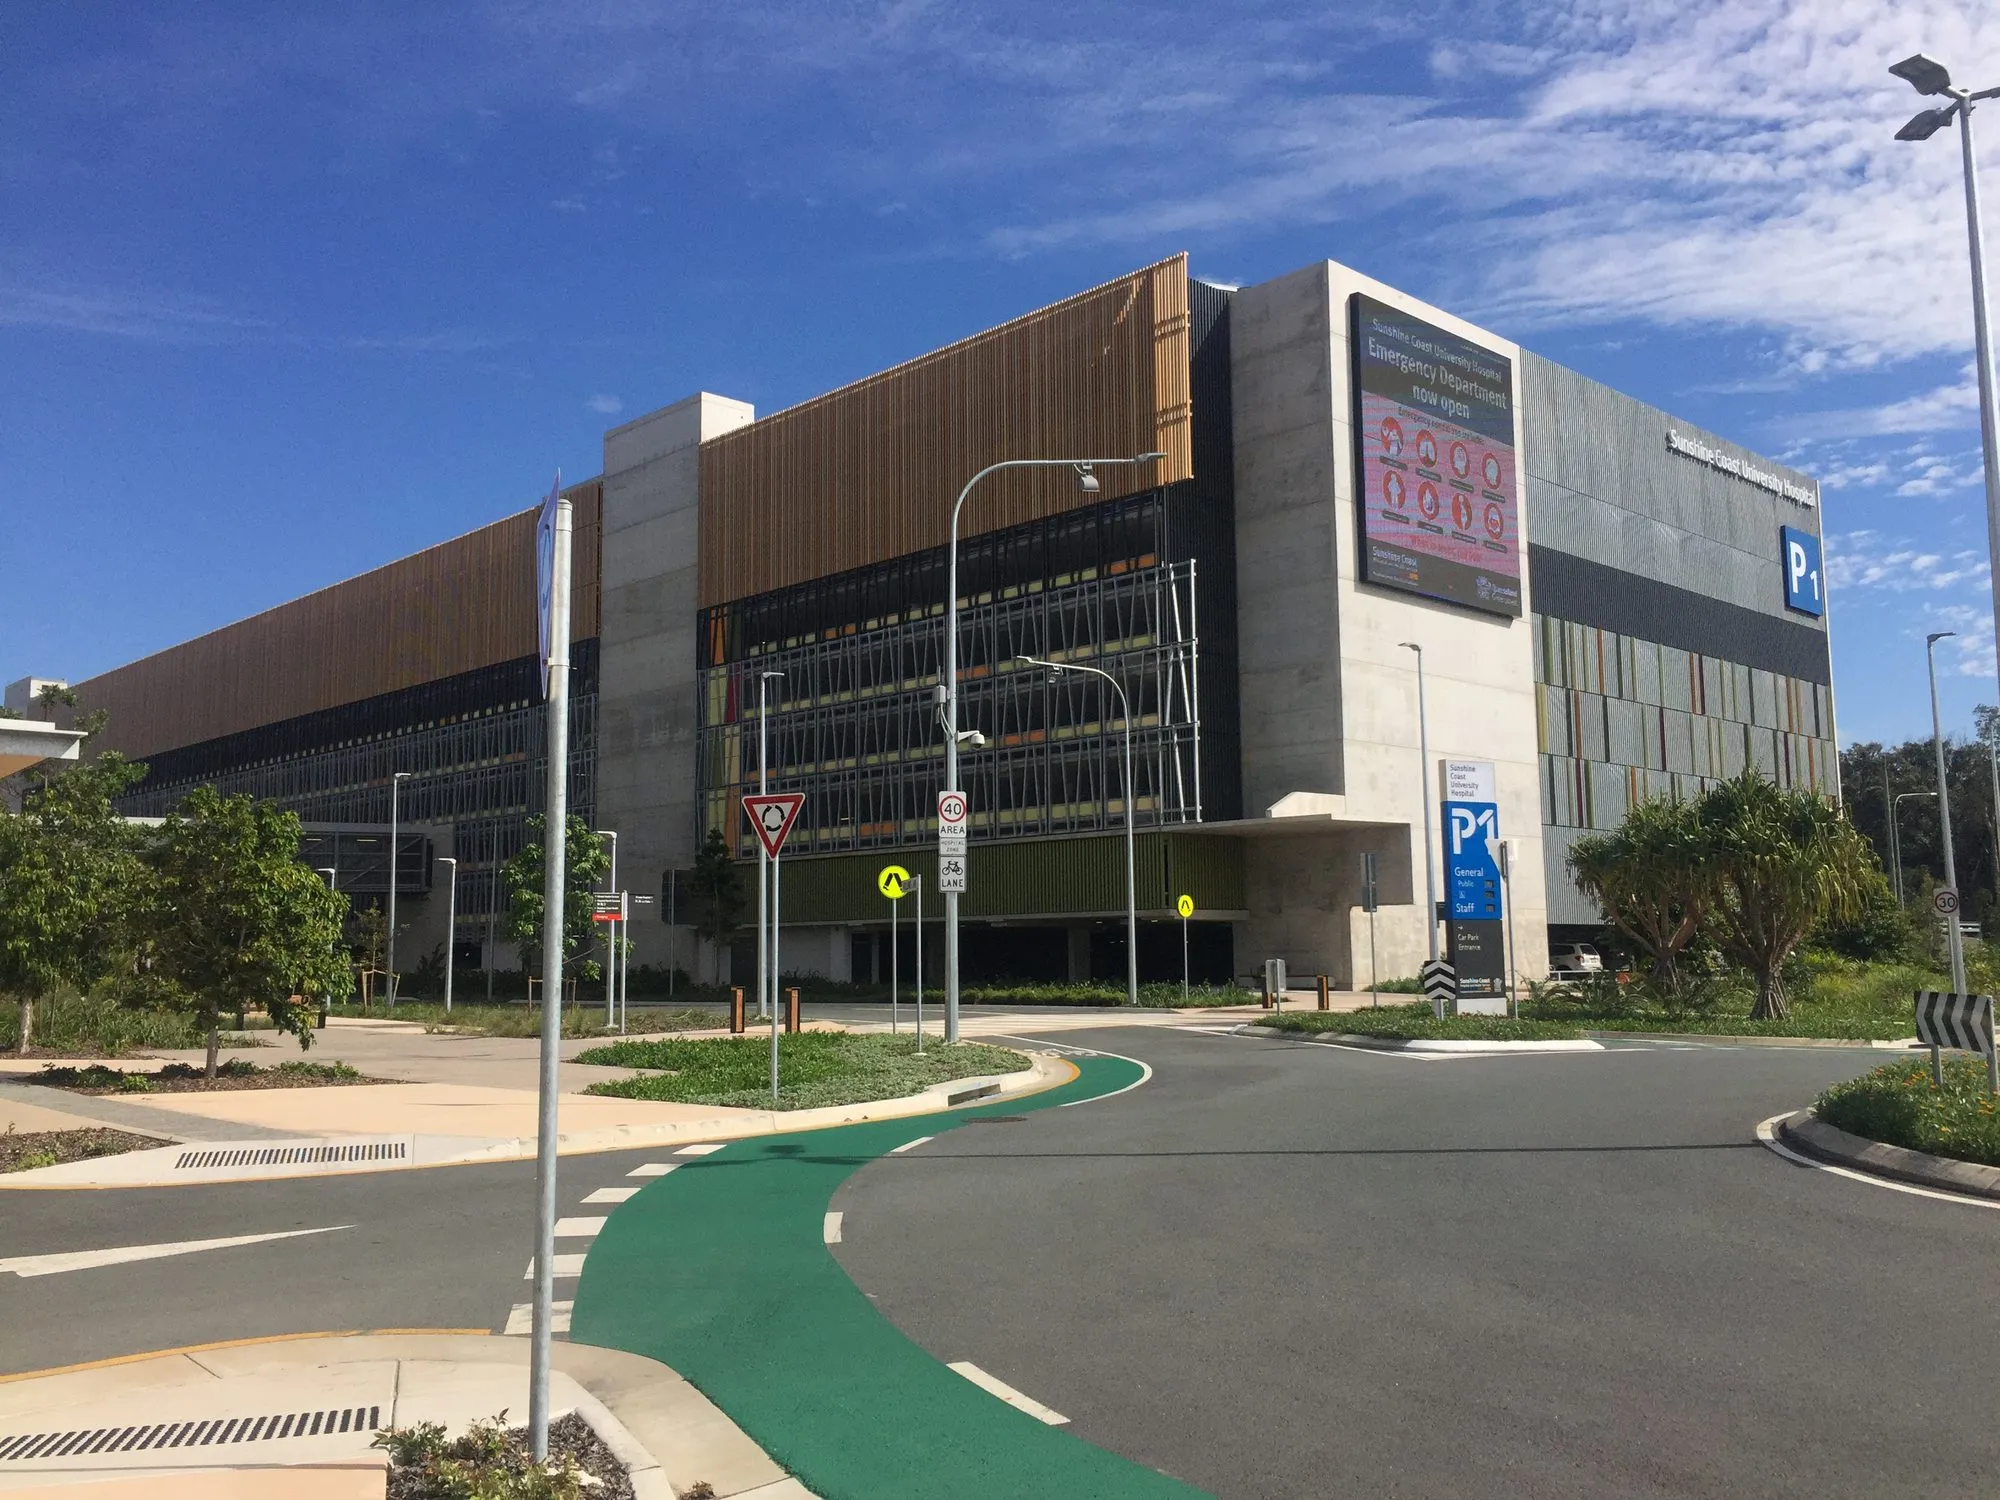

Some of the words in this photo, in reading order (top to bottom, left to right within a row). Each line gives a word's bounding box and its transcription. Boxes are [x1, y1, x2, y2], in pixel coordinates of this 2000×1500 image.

[1372, 318, 1409, 344] Sunshine
[1411, 335, 1433, 353] Coast
[1434, 345, 1471, 372] University
[1472, 360, 1501, 383] Hospital
[1368, 336, 1437, 385] Emergency
[1439, 365, 1508, 410] Department
[1412, 385, 1438, 406] now
[1440, 395, 1470, 419] open
[1670, 429, 1714, 463] Sunshine
[1715, 449, 1741, 477] Coast
[1742, 460, 1783, 496] University
[1784, 477, 1816, 507] Hospital
[1450, 764, 1476, 772] Sunshine
[1451, 781, 1479, 789] University
[1451, 790, 1475, 798] Hospital
[944, 803, 962, 815] 40
[940, 826, 965, 834] AREA
[1454, 867, 1484, 877] General
[941, 879, 964, 887] LANE
[1939, 897, 1955, 907] 30
[1456, 903, 1475, 913] Staff
